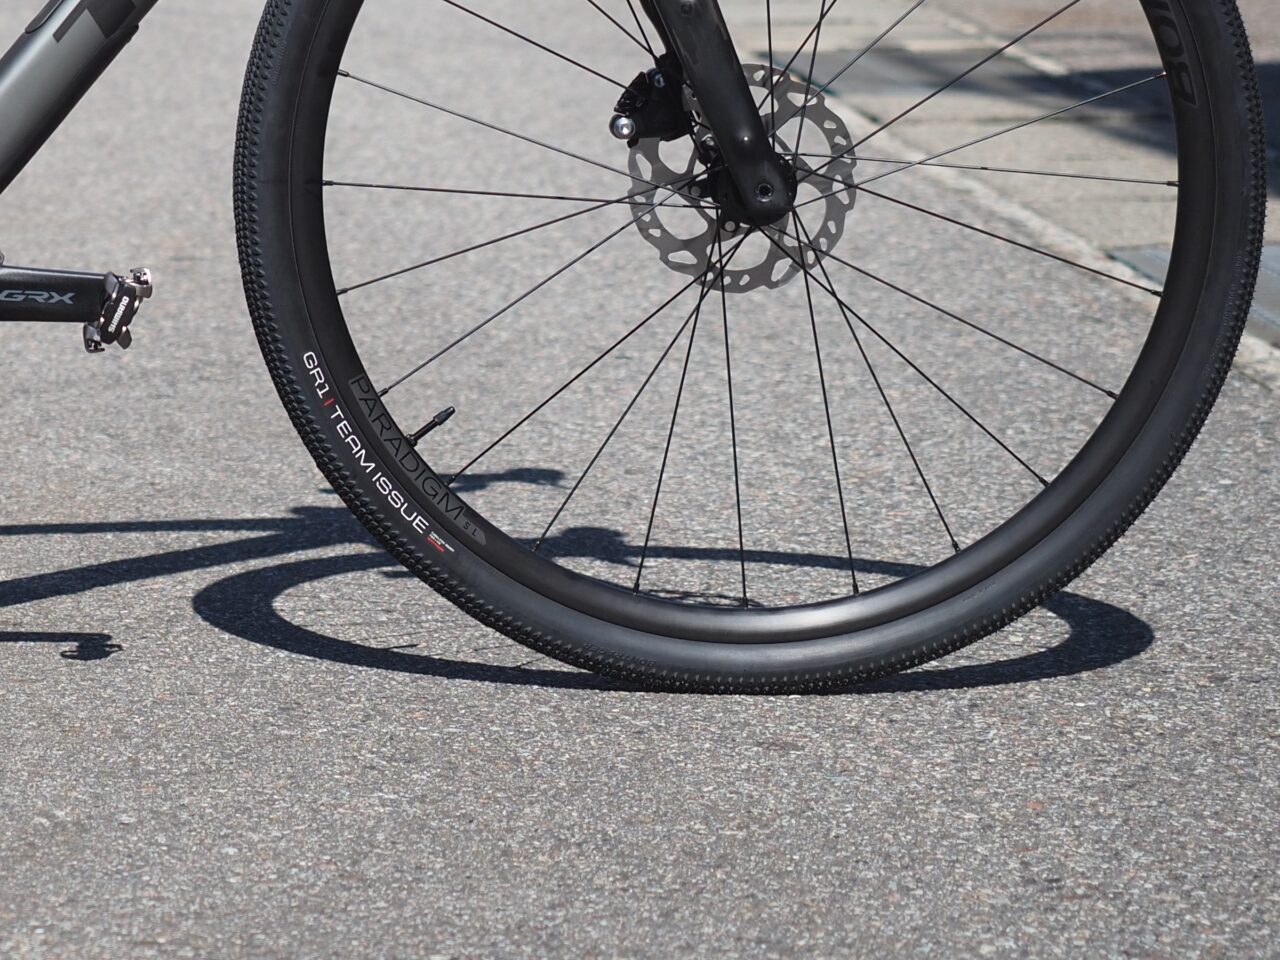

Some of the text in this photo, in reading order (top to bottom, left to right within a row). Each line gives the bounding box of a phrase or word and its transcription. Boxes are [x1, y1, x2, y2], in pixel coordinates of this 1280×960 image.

[108, 295, 130, 333] SHIMANO
[303, 351, 429, 534] GR1 TEAM ISSUE
[351, 376, 465, 520] PARADIGM
